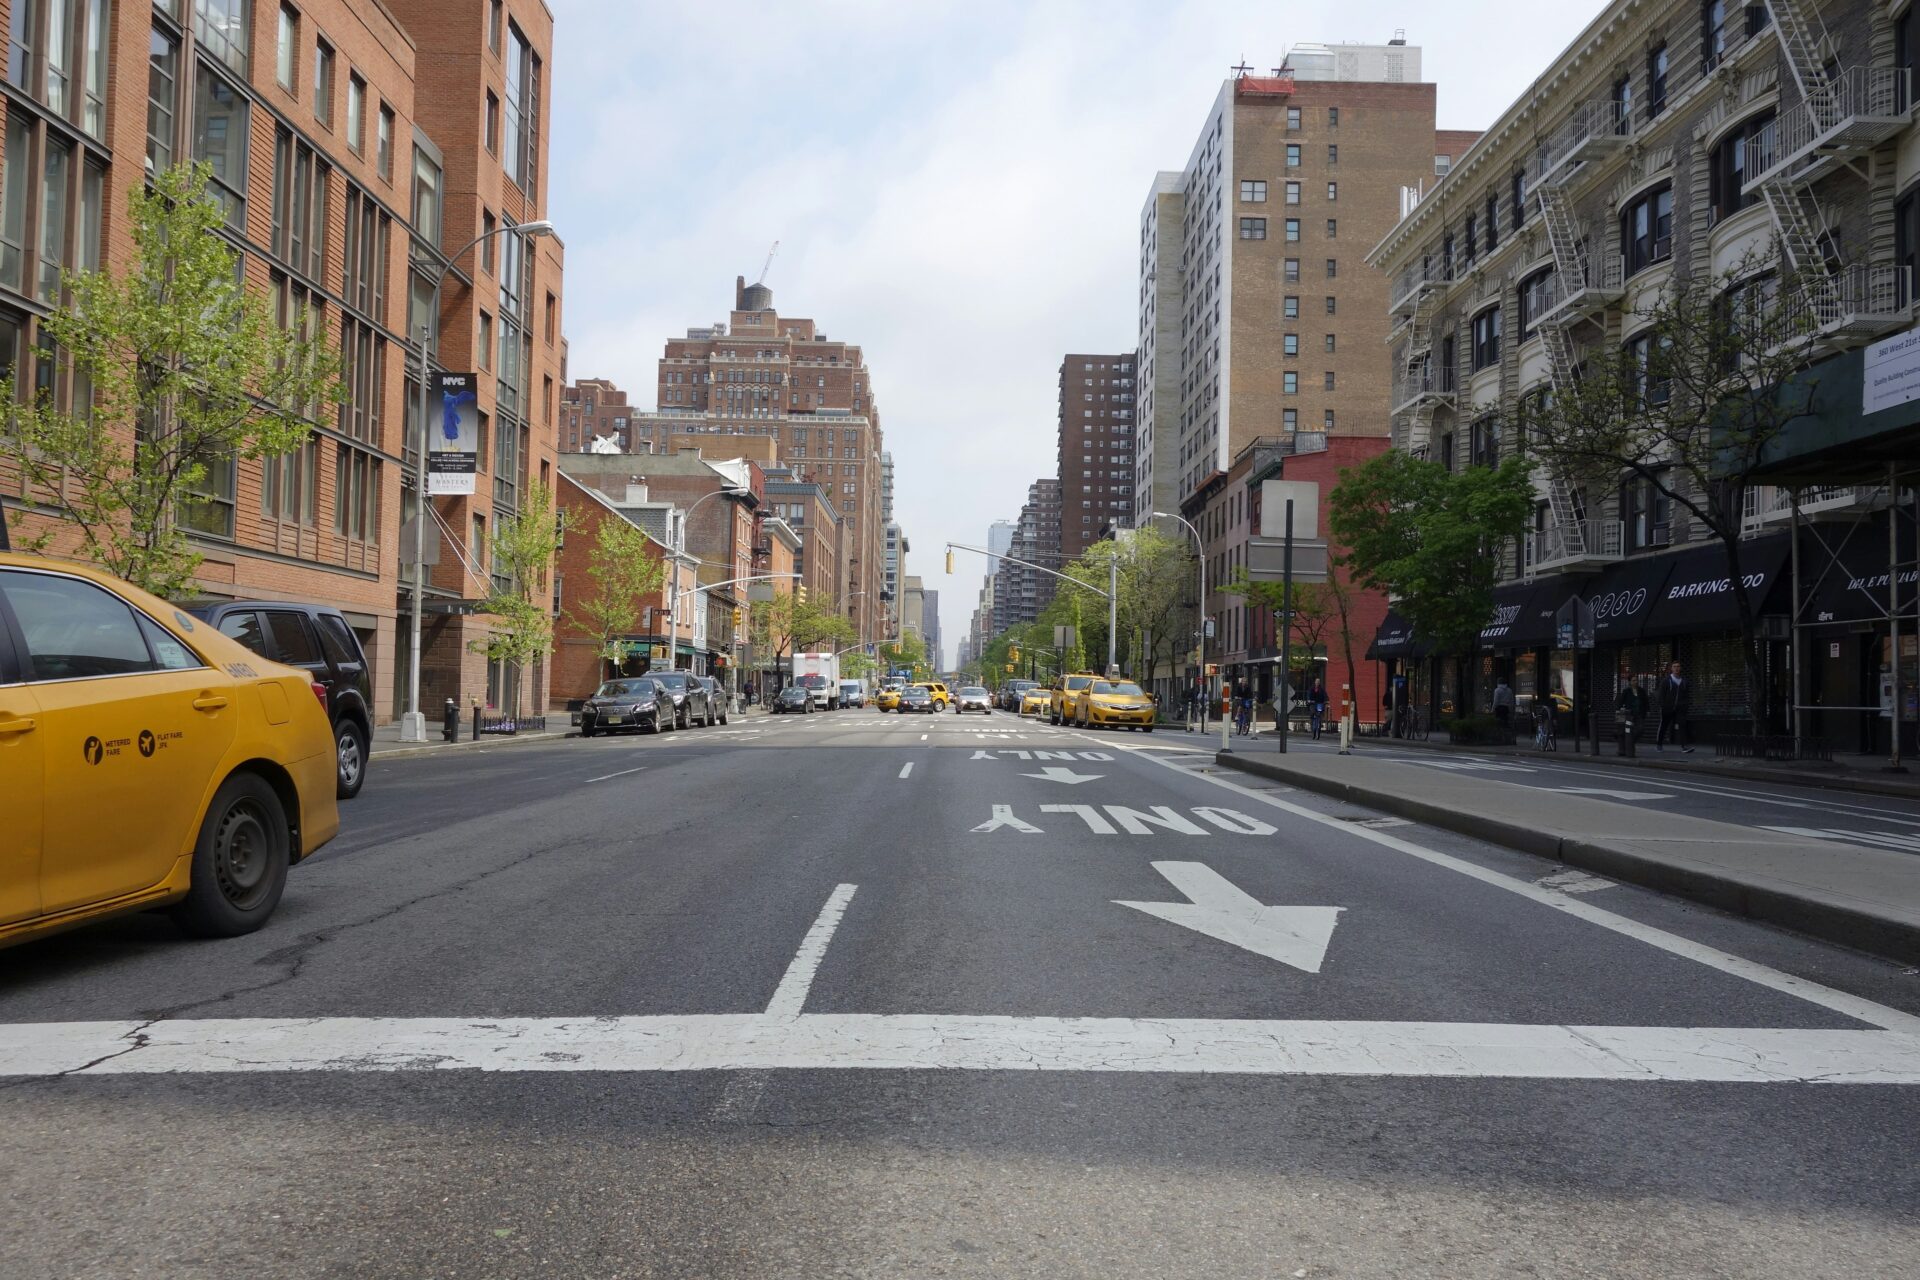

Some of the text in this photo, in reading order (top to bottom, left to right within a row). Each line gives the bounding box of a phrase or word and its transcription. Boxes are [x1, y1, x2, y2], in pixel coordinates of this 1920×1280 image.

[1890, 342, 1904, 353] West
[1905, 337, 1918, 348] 21st
[442, 377, 466, 386] NYC
[1668, 573, 1765, 600] BARKING OO
[1589, 590, 1646, 617] NEST
[1480, 627, 1509, 638] BAKERY
[157, 731, 183, 741] FLAT FARE
[105, 738, 131, 748] METERED
[158, 742, 168, 750] JFK
[106, 748, 121, 757] FARE
[969, 750, 1116, 761] ONLY
[969, 804, 1279, 836] ONLY
